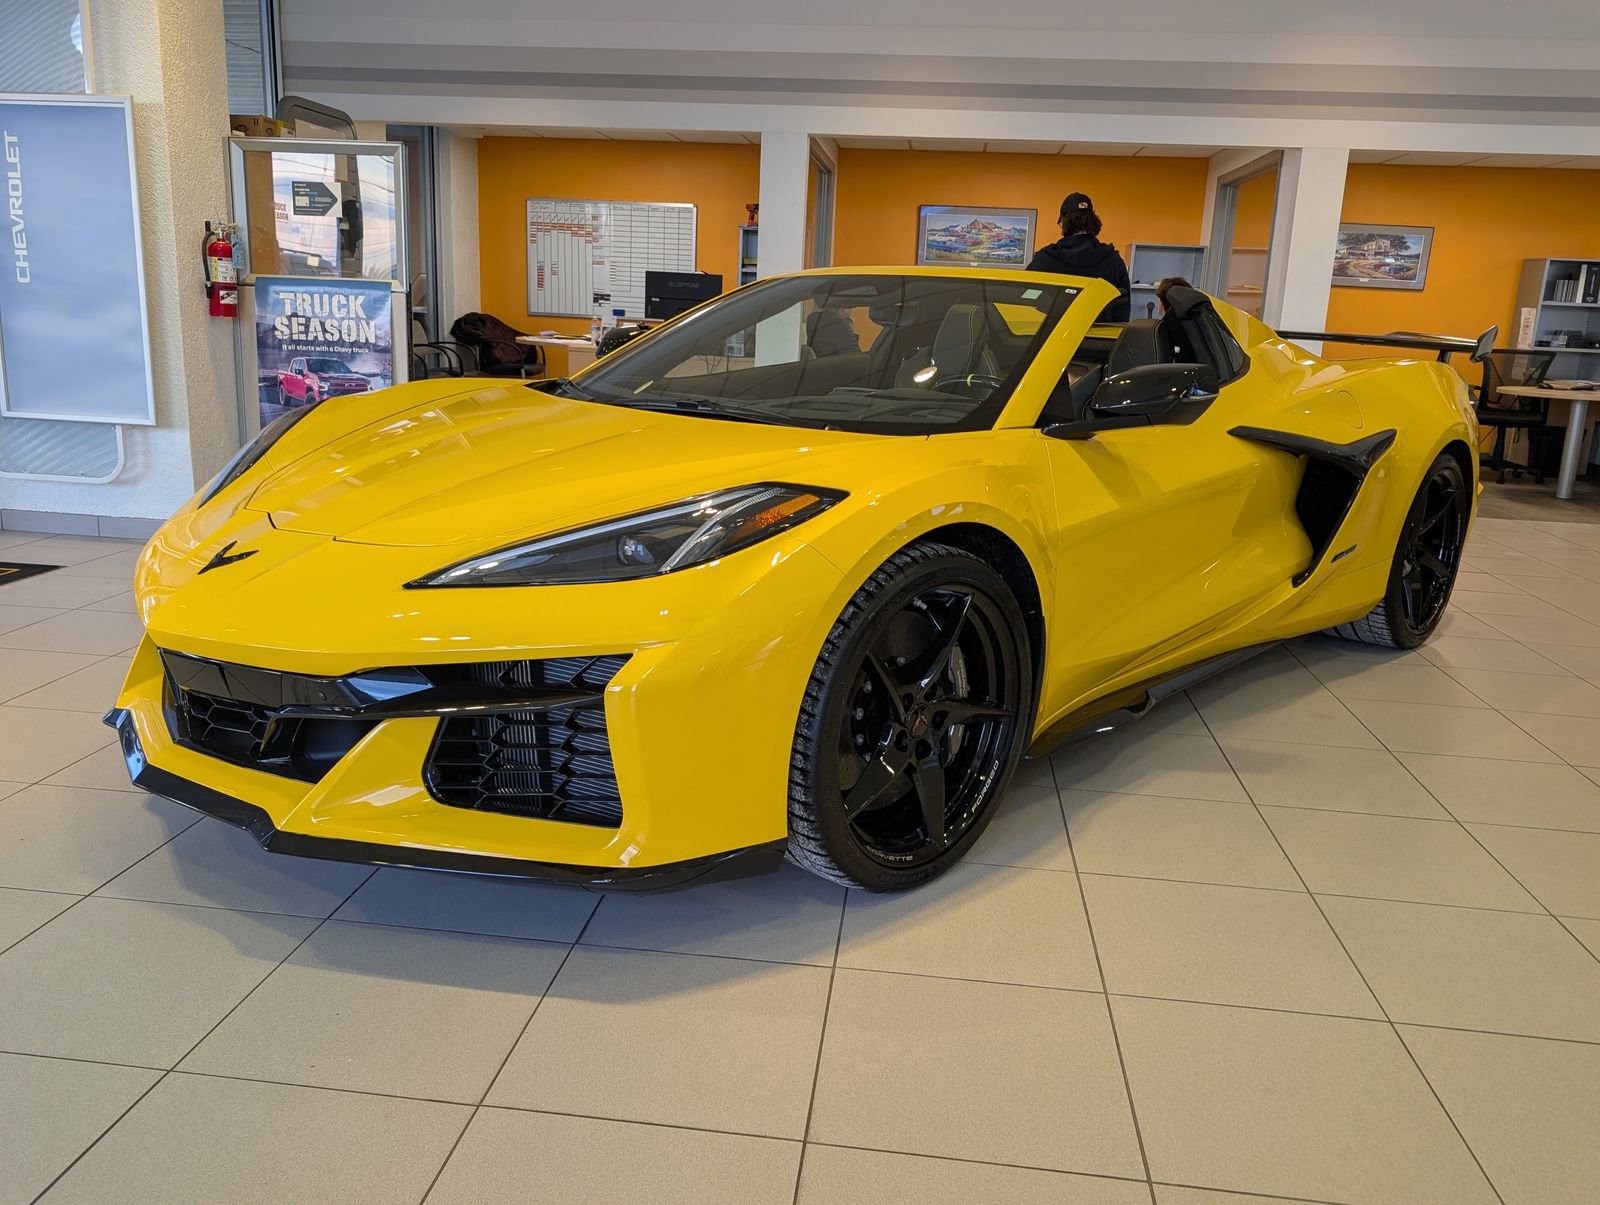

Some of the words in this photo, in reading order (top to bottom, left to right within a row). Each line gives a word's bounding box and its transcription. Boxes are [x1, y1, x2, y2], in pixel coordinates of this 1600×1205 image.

[4, 130, 31, 284] CHEVROLET
[279, 292, 367, 319] TRUCK
[274, 316, 376, 344] SEASON
[334, 346, 352, 354] Chevy
[971, 760, 999, 813] FORGED
[866, 845, 913, 861] CORVETTE
